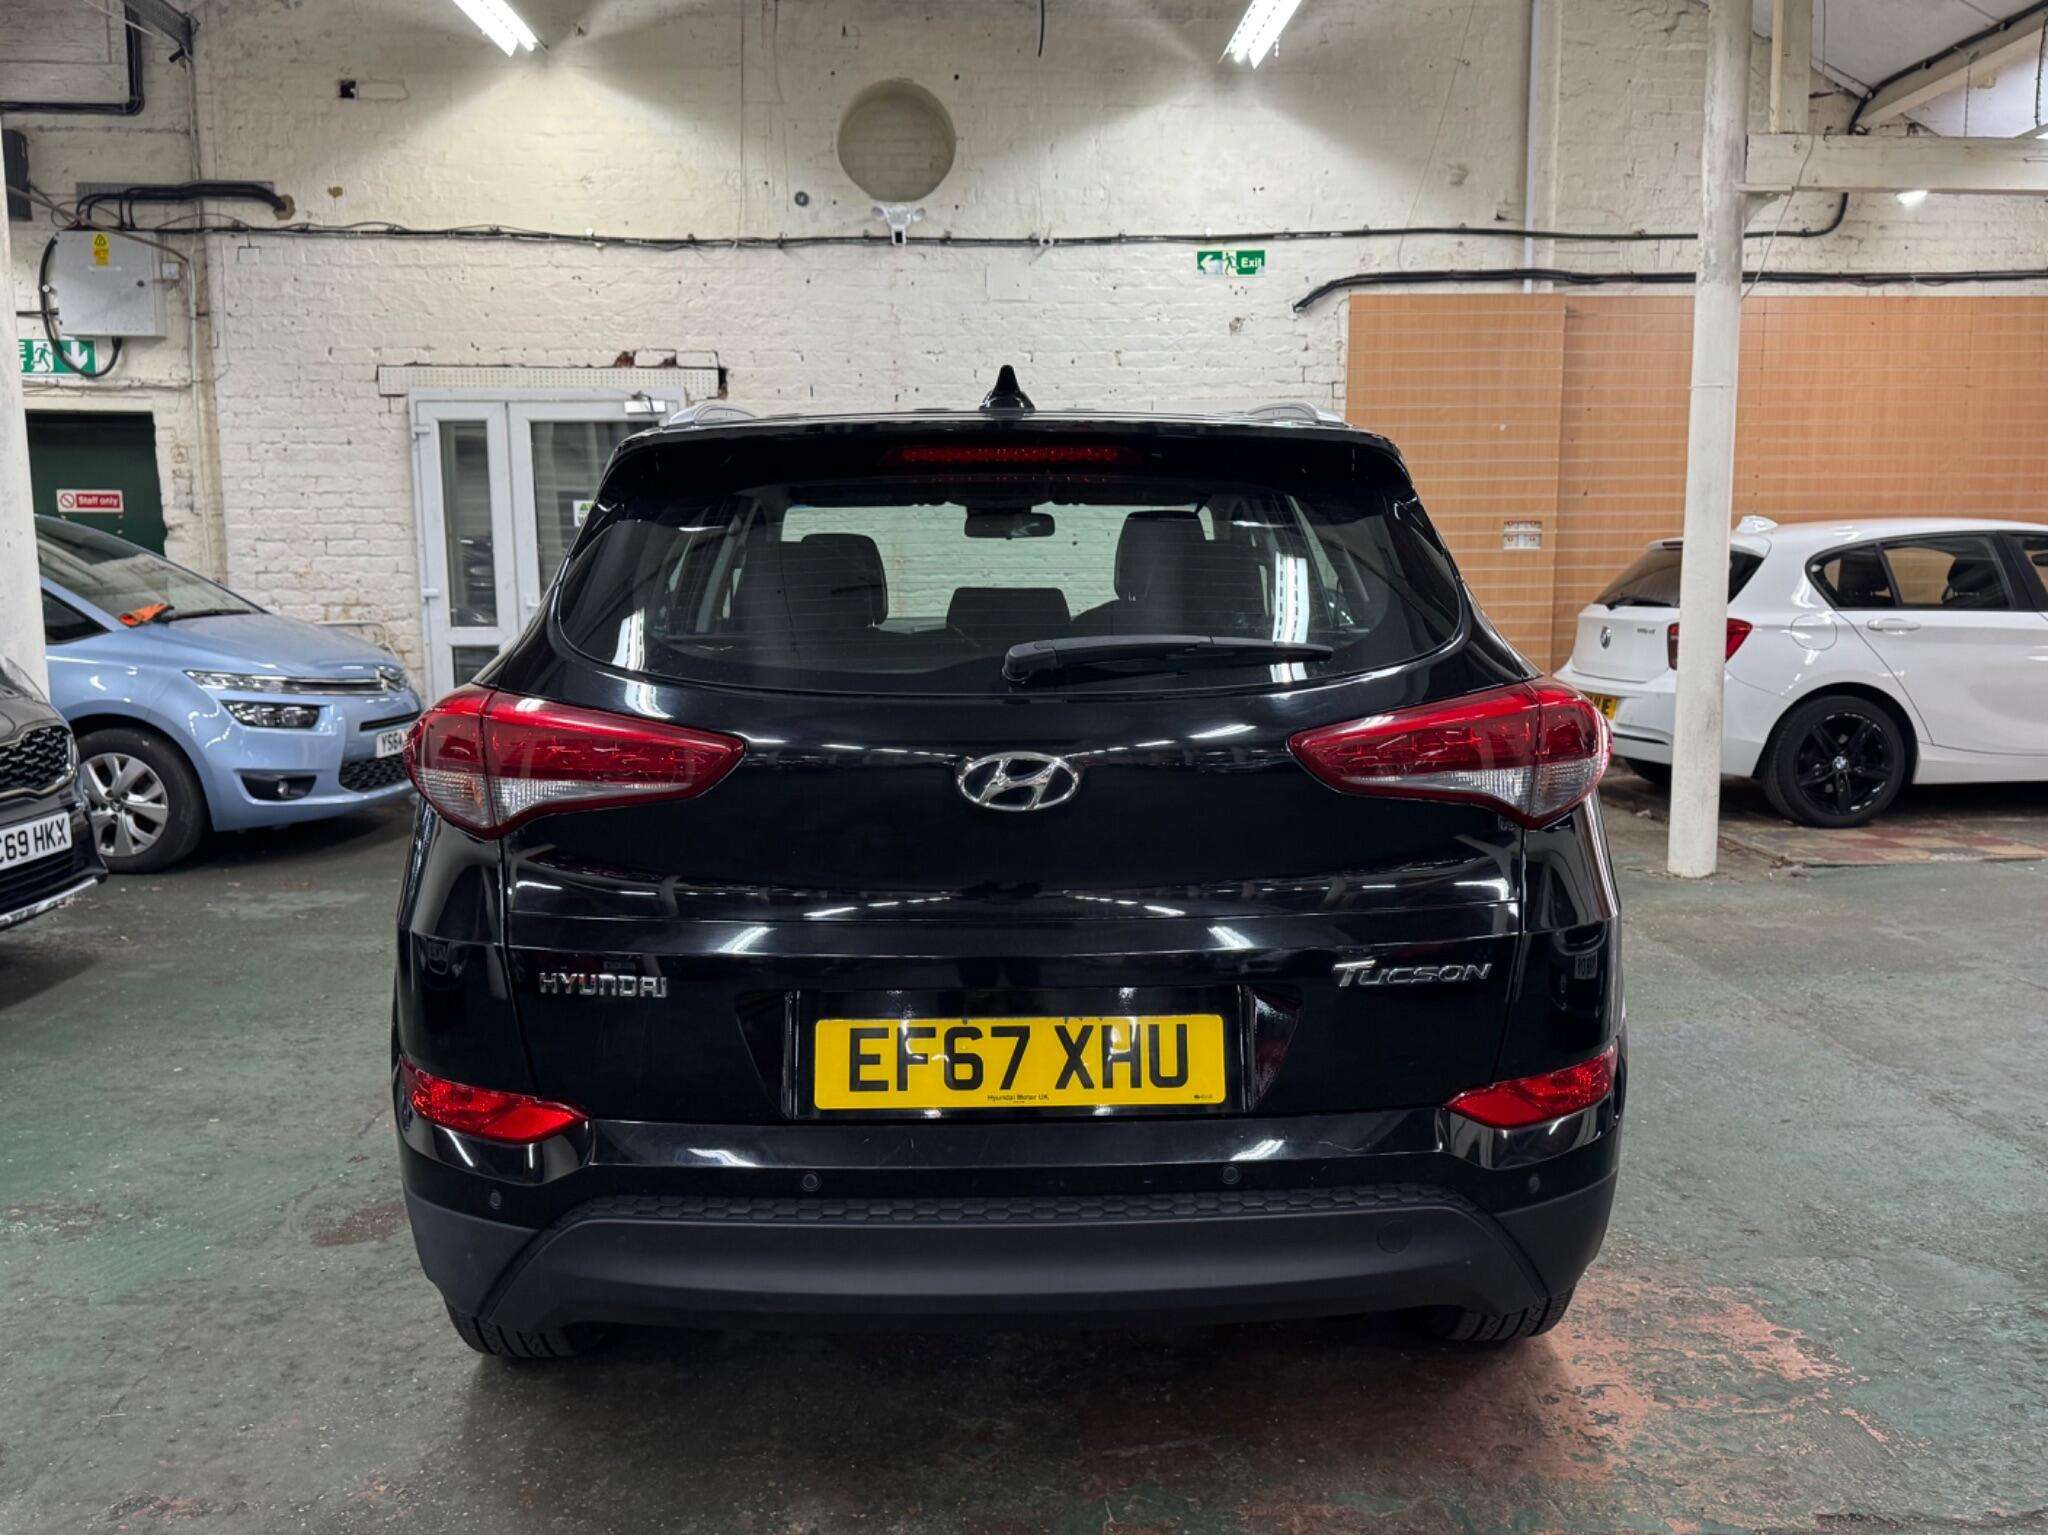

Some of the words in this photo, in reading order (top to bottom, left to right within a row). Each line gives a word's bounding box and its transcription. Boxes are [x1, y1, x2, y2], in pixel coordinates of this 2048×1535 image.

[1241, 257, 1262, 268] Exit
[78, 495, 98, 505] Staff
[99, 495, 118, 507] only
[33, 817, 67, 853] HKX
[539, 972, 668, 999] HYUNDAI
[848, 1026, 1031, 1092] EF67
[1054, 1024, 1190, 1090] XHU
[987, 1093, 1016, 1102] Hyundai
[1016, 1093, 1037, 1101] Motor
